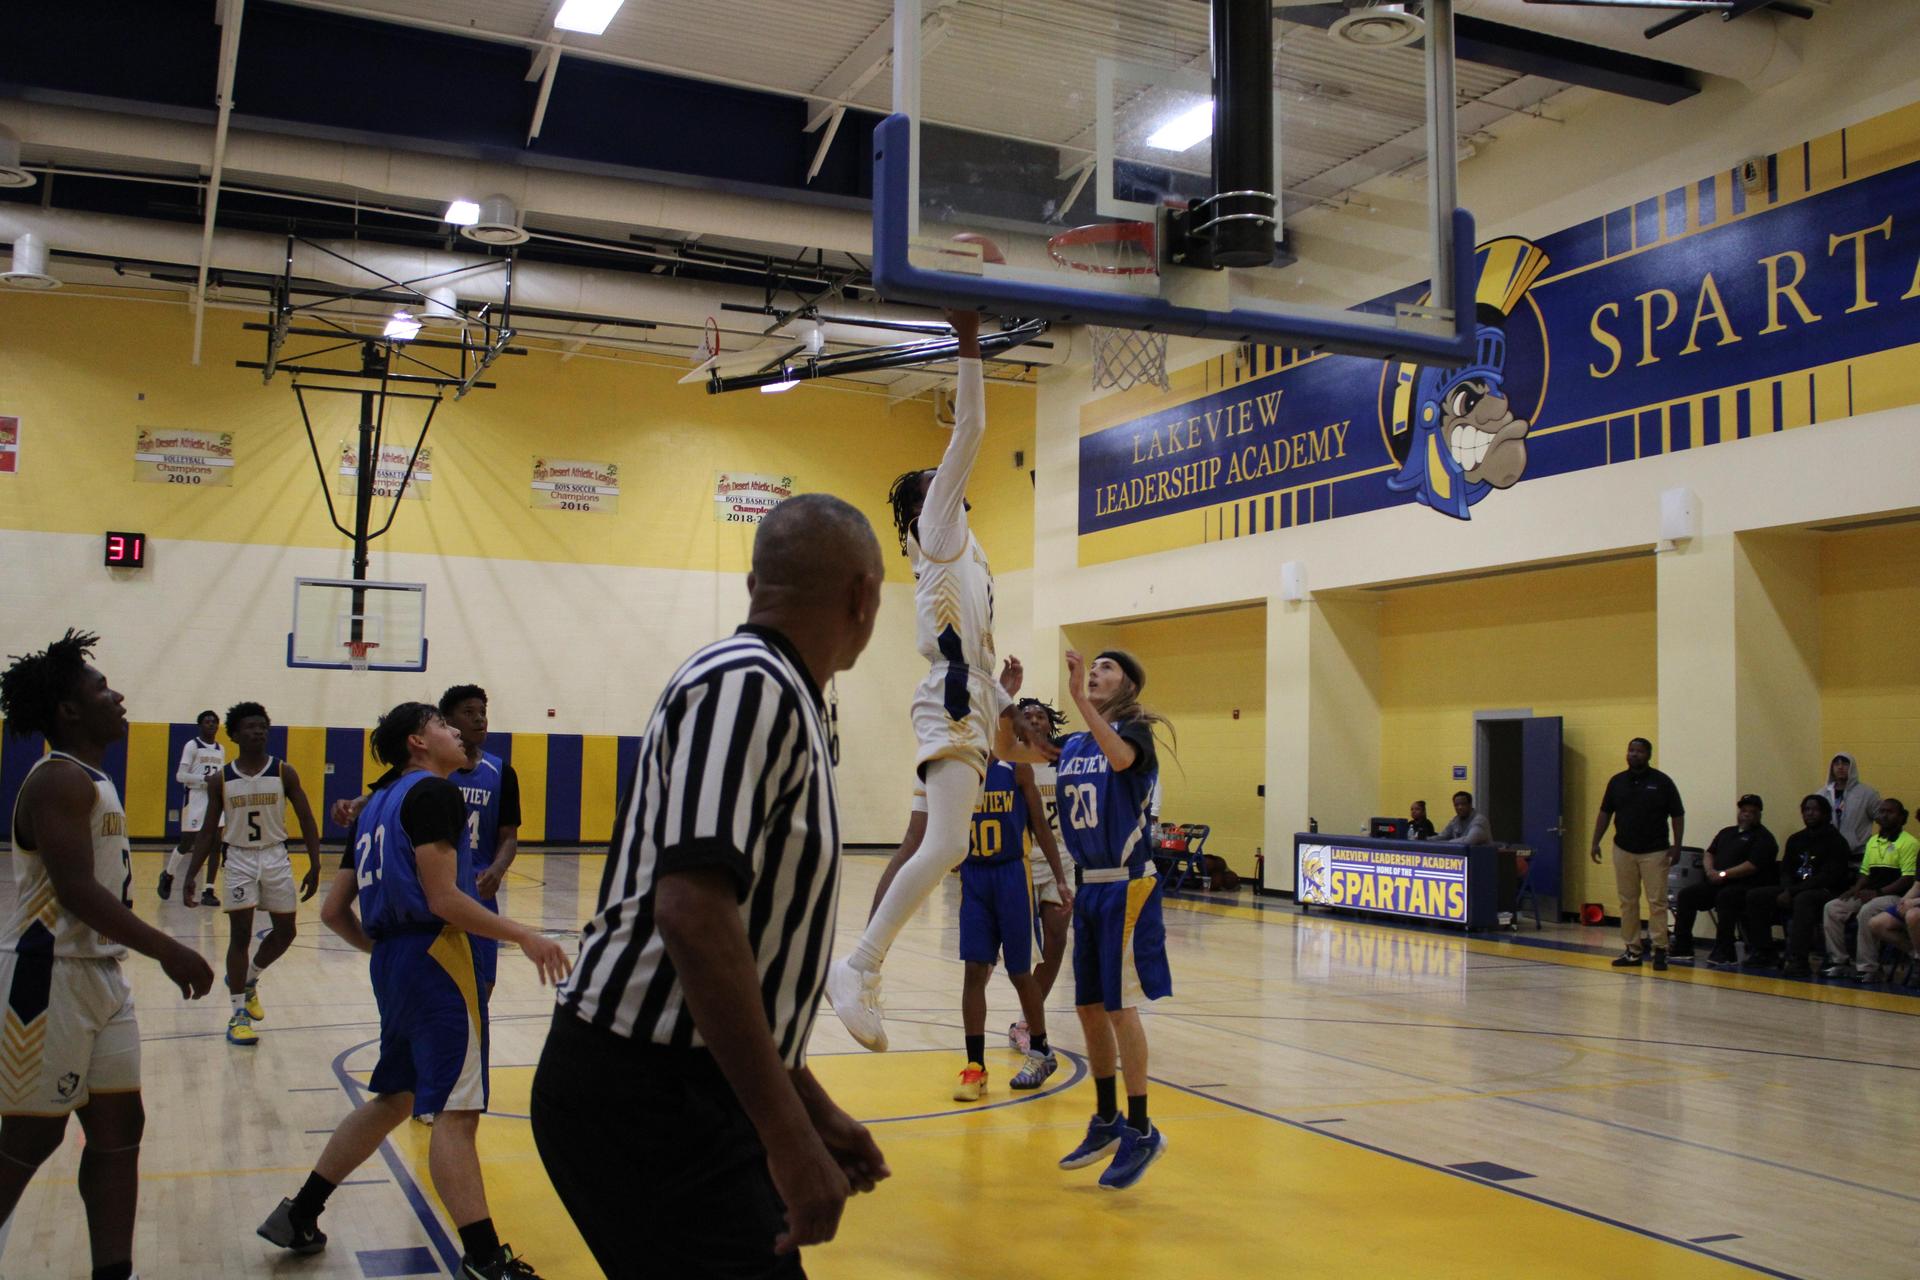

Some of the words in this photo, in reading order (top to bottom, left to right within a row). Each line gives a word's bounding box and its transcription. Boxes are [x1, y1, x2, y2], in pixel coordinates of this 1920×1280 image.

[1131, 389, 1284, 464] LAKEVIEW
[156, 463, 212, 475] Champions
[163, 454, 205, 465] VOLLEYBALL
[1095, 456, 1221, 517] LEADERSHIP
[1226, 420, 1351, 485] ACADEMY
[168, 474, 201, 484] 2010
[549, 467, 570, 477] Desert
[572, 467, 594, 480] Athletic
[595, 470, 617, 485] League
[731, 481, 750, 491] Desert
[550, 491, 600, 502] Champions
[554, 482, 570, 491] BOYS
[572, 484, 596, 493] SOCCER
[560, 501, 590, 511] 2016
[725, 496, 743, 504] BOYS
[109, 536, 140, 560] 31
[1058, 754, 1108, 777] LAKEVIEW
[459, 786, 492, 807] VIEW
[975, 790, 1015, 813] VIEW
[1064, 782, 1099, 830] 20
[247, 811, 261, 842] 5
[970, 819, 1002, 857] 10
[1331, 848, 1369, 862] LAKEVIEW
[1371, 852, 1421, 867] LEADERSHIP
[1422, 856, 1464, 871] ACADEMY
[1376, 865, 1393, 875] HOME
[1401, 868, 1413, 877] THE
[1331, 870, 1465, 919] SPARTANS
